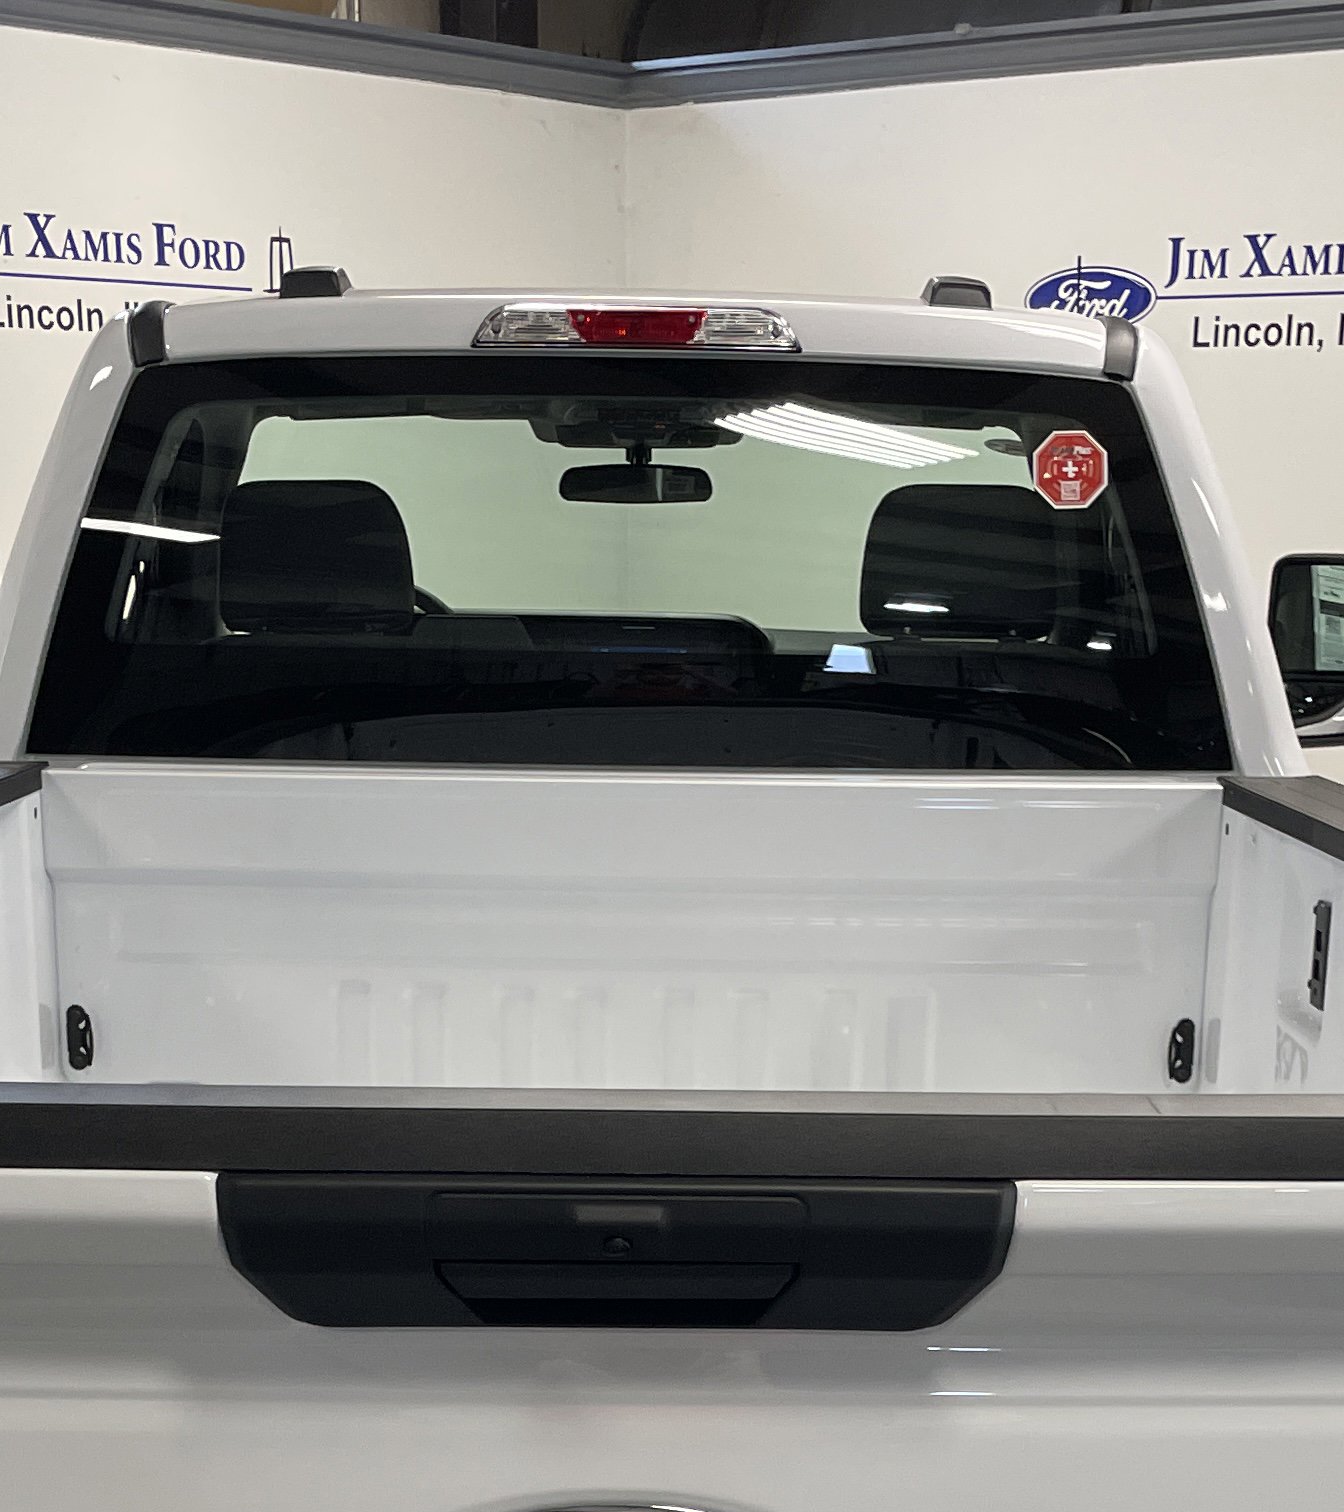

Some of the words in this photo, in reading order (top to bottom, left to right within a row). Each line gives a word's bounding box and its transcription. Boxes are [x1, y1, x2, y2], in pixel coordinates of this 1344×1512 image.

[23, 212, 143, 266] XAMIS
[152, 222, 246, 272] FORD
[1164, 237, 1230, 289] JIM
[1192, 313, 1324, 352] Lincoln,
